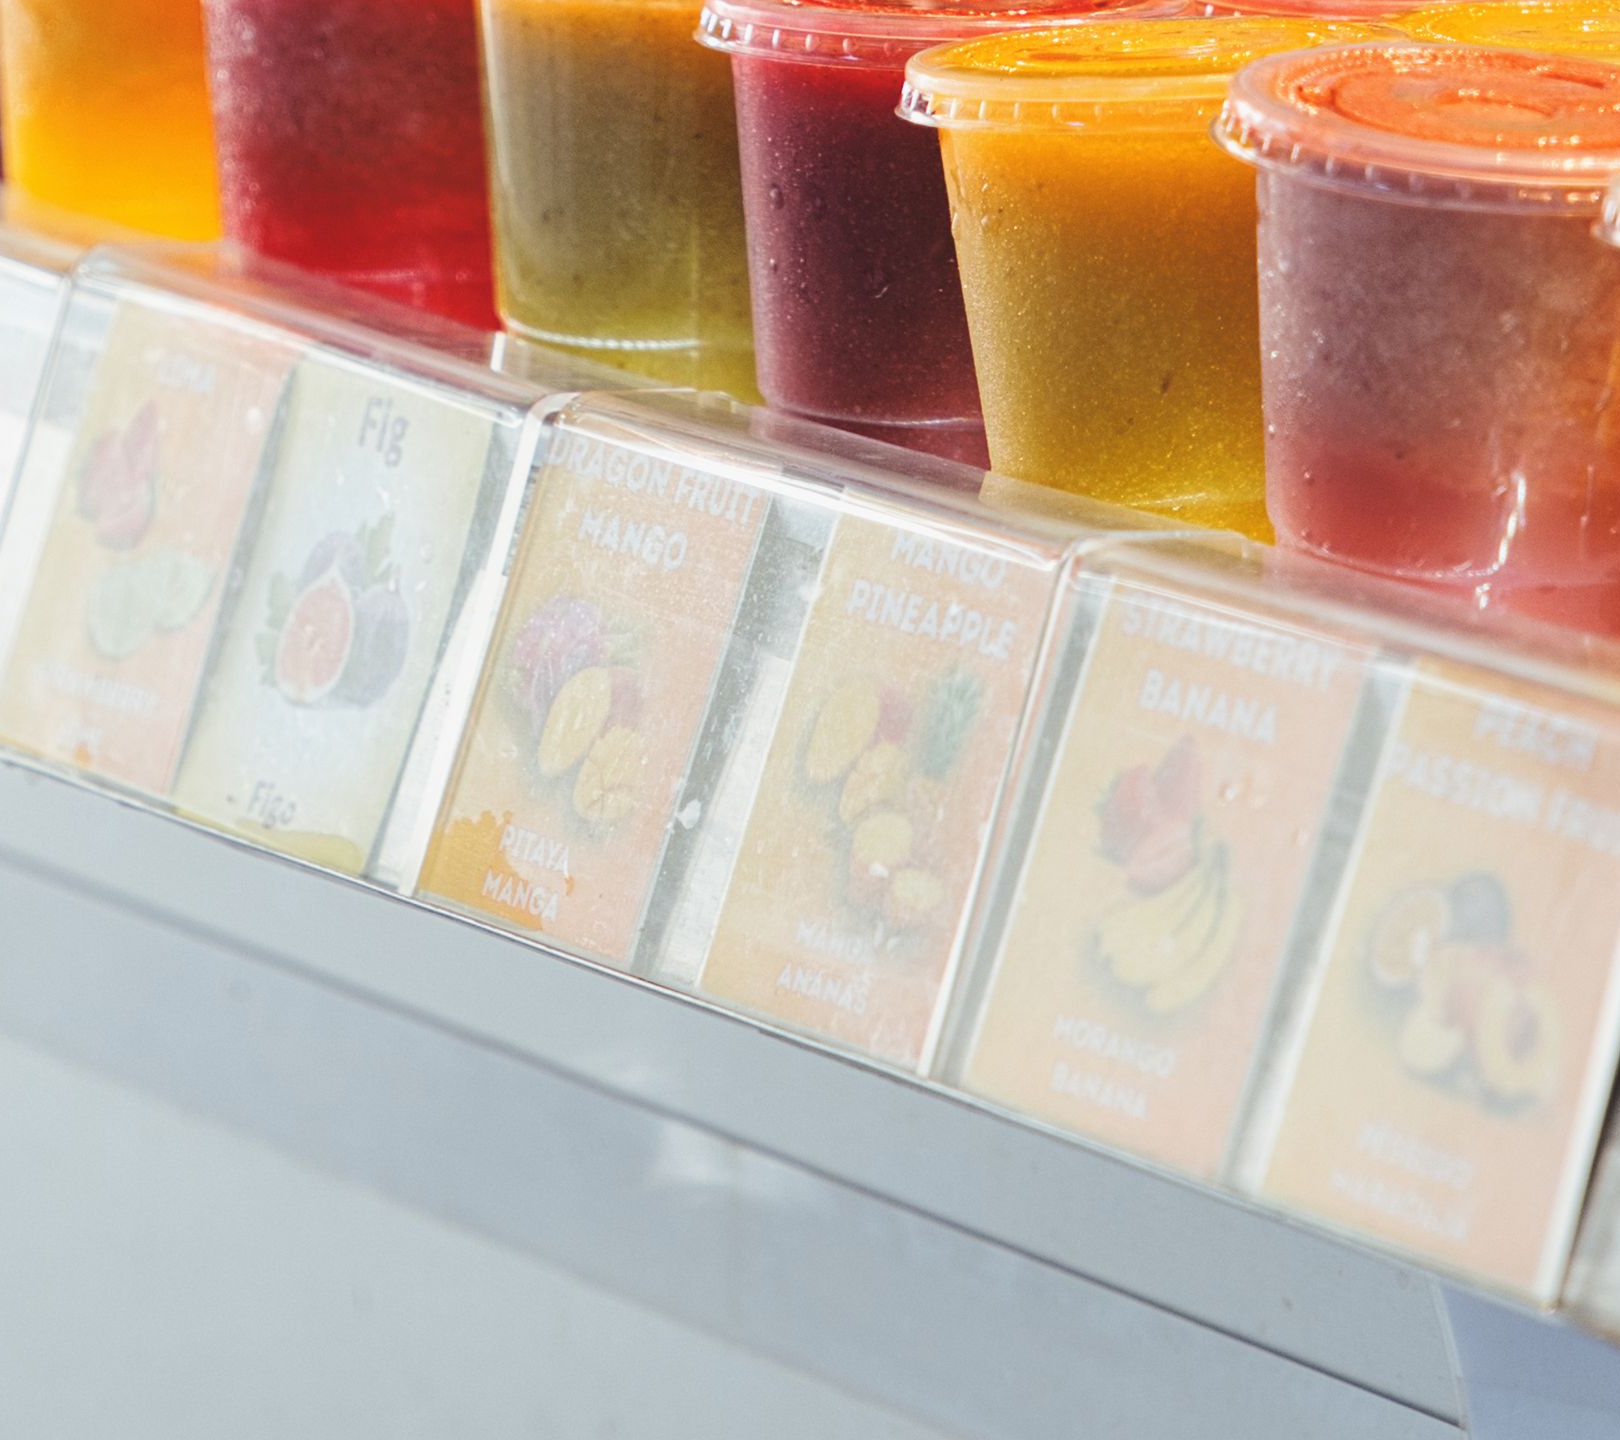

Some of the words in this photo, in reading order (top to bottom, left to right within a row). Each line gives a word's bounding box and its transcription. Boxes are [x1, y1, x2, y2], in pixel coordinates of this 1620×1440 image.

[357, 396, 411, 469] Fig
[548, 432, 673, 497] DRAGON
[674, 468, 761, 526] FRUIT
[577, 505, 689, 570] MANGO
[890, 528, 1007, 590] MANGO
[845, 578, 1017, 659] PINEAPPLE
[1122, 597, 1343, 693] STRAWBERRY
[1139, 667, 1277, 745] BANANA
[247, 780, 298, 831] Figo
[498, 824, 571, 879] PITAYA
[481, 868, 559, 922] MANGA
